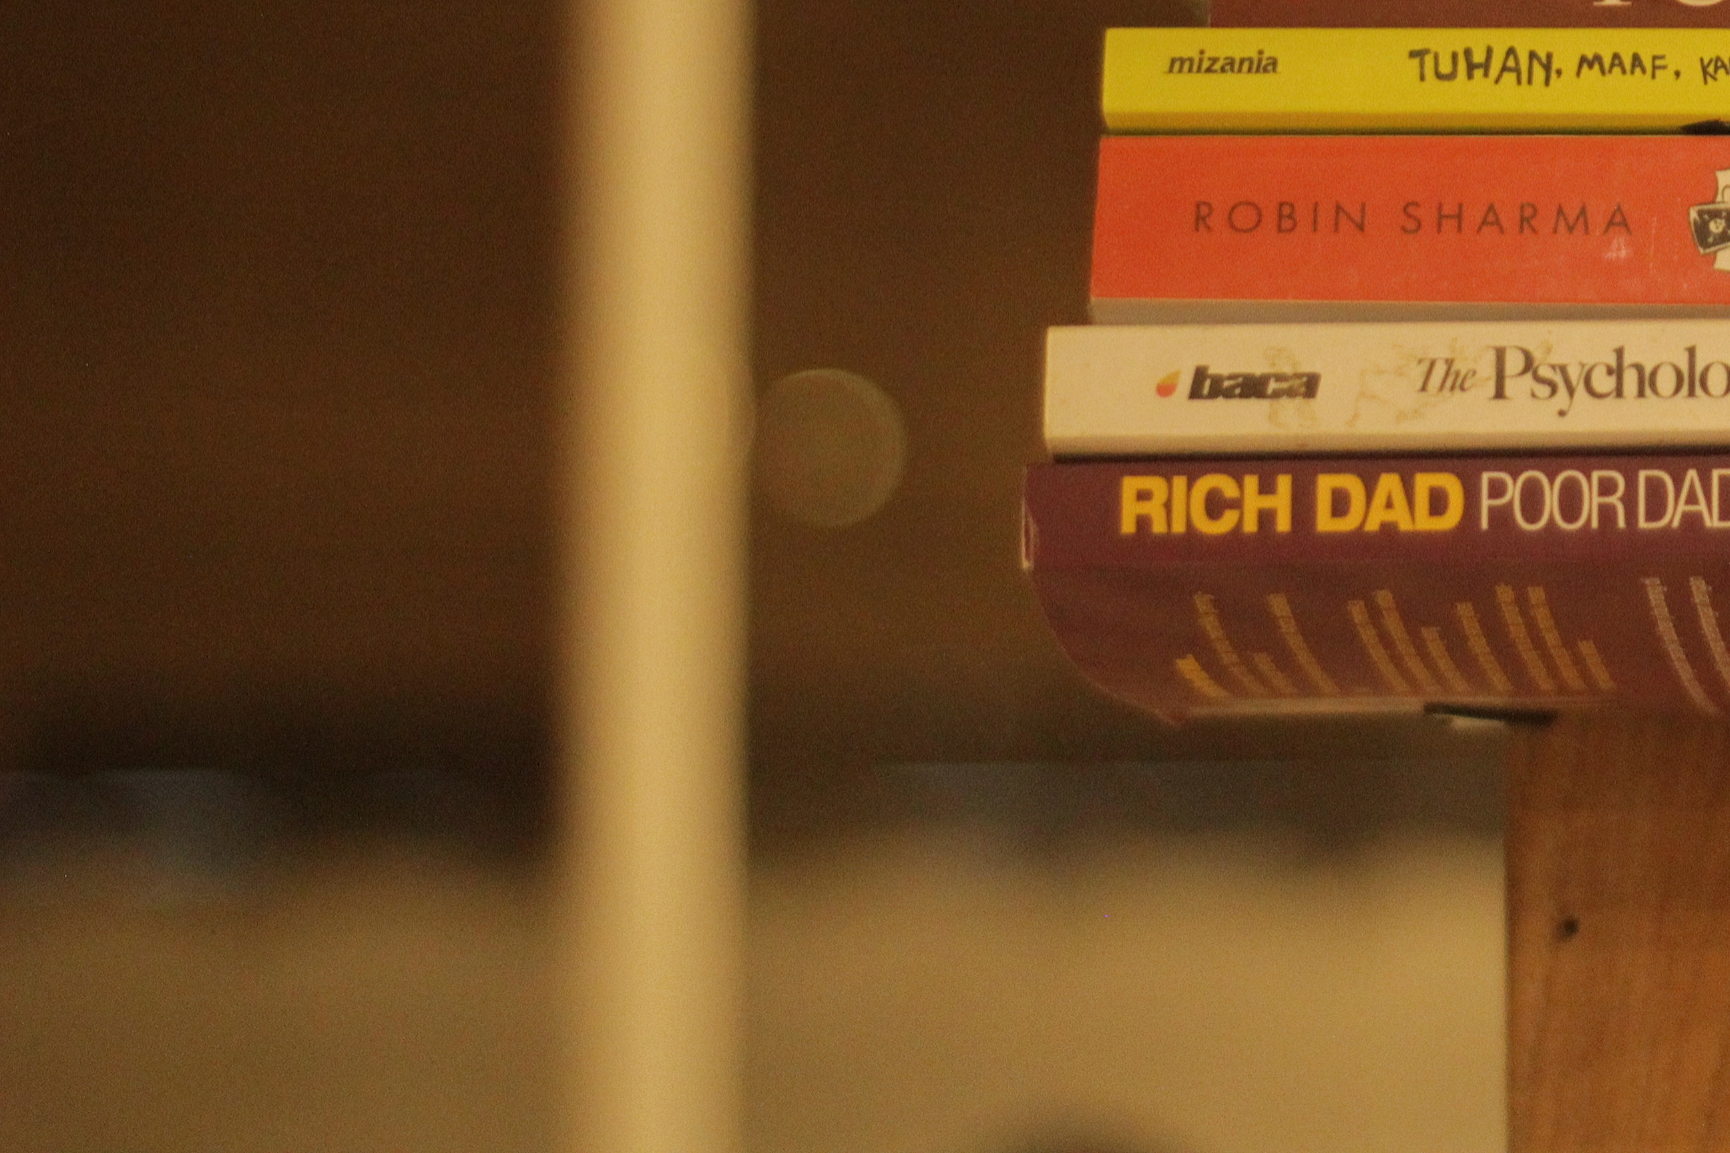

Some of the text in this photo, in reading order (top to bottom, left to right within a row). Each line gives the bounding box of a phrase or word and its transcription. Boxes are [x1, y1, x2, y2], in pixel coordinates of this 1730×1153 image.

[1166, 49, 1280, 75] mizania
[1408, 47, 1562, 86] TUHAN,
[1576, 52, 1681, 80] MAAF,
[1194, 201, 1632, 235] ROBIN SHARMA
[1188, 364, 1321, 401] baca
[1417, 357, 1478, 395] The
[1119, 474, 1292, 535] RICH
[1316, 472, 1464, 532] DAD
[1480, 469, 1626, 530] POOR
